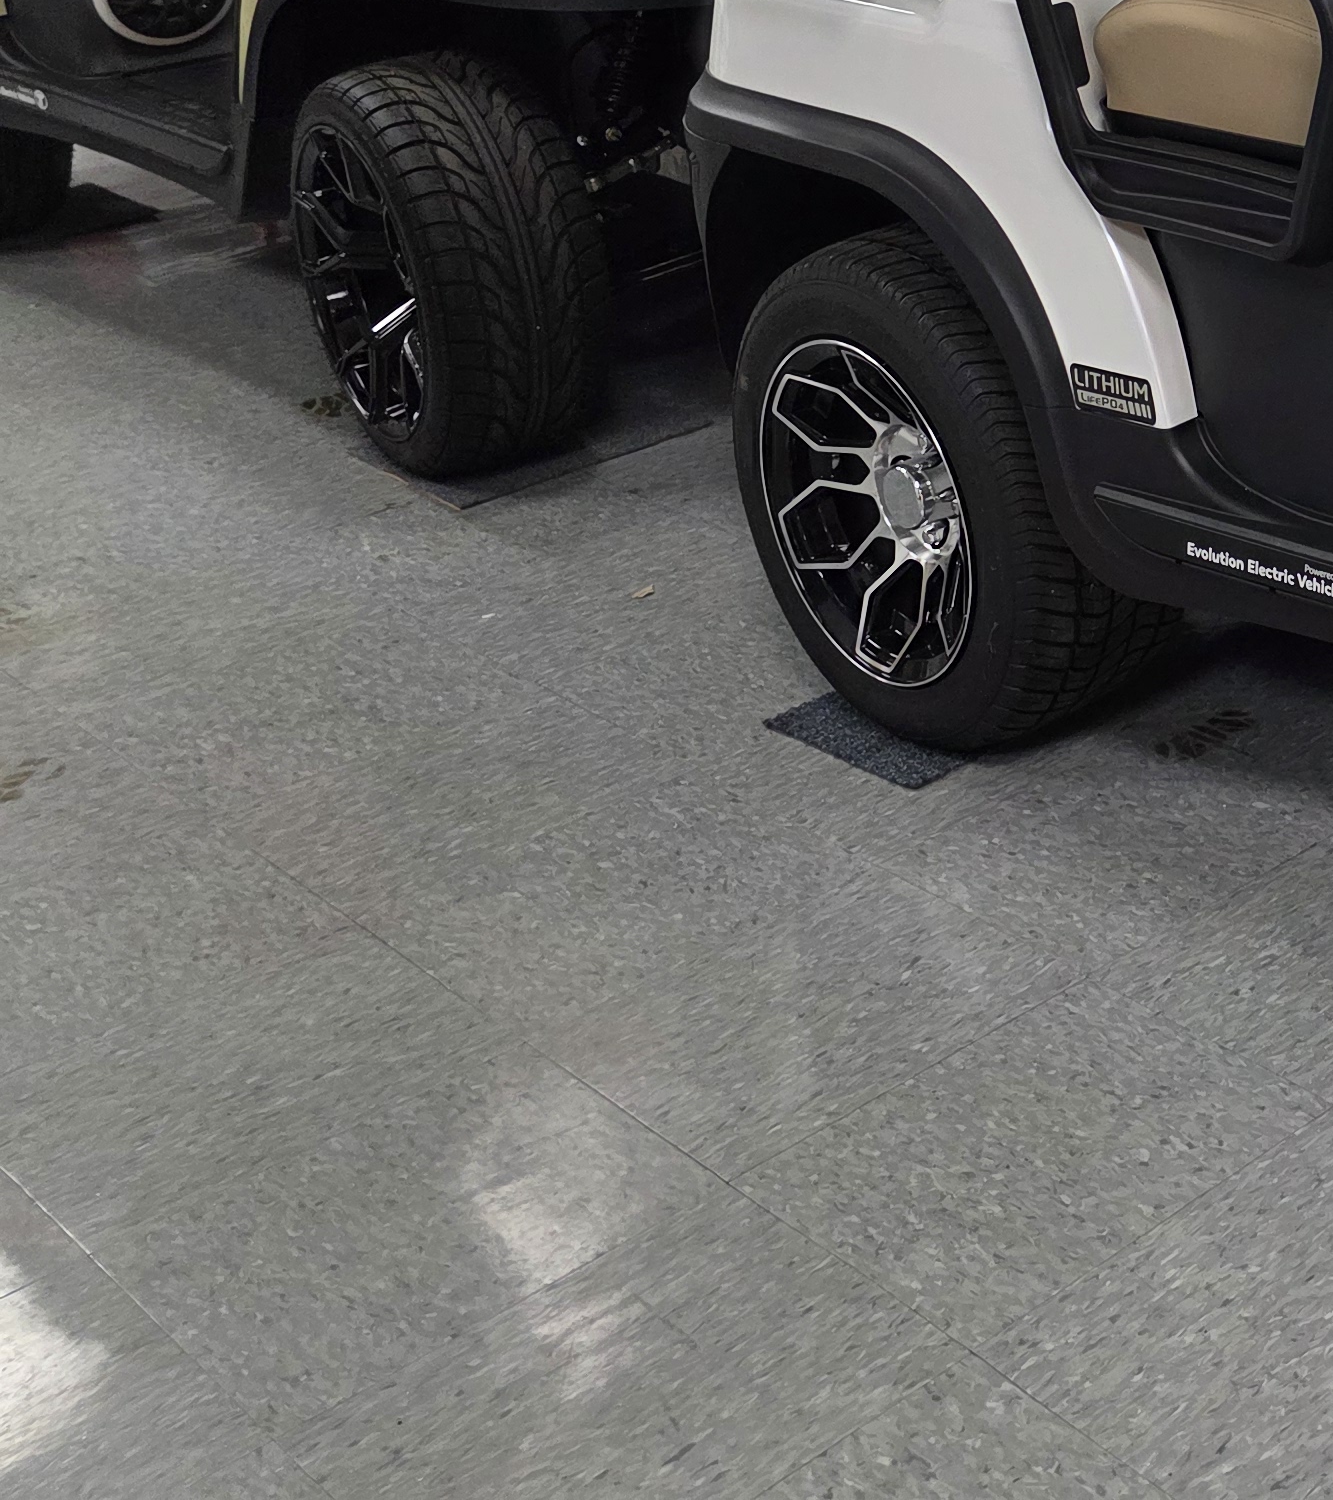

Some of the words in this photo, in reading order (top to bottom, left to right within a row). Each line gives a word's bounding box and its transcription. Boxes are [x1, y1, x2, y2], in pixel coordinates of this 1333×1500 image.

[1073, 367, 1149, 402] LITHIUM
[1186, 541, 1245, 572] Evolution
[1246, 558, 1296, 586] Electric
